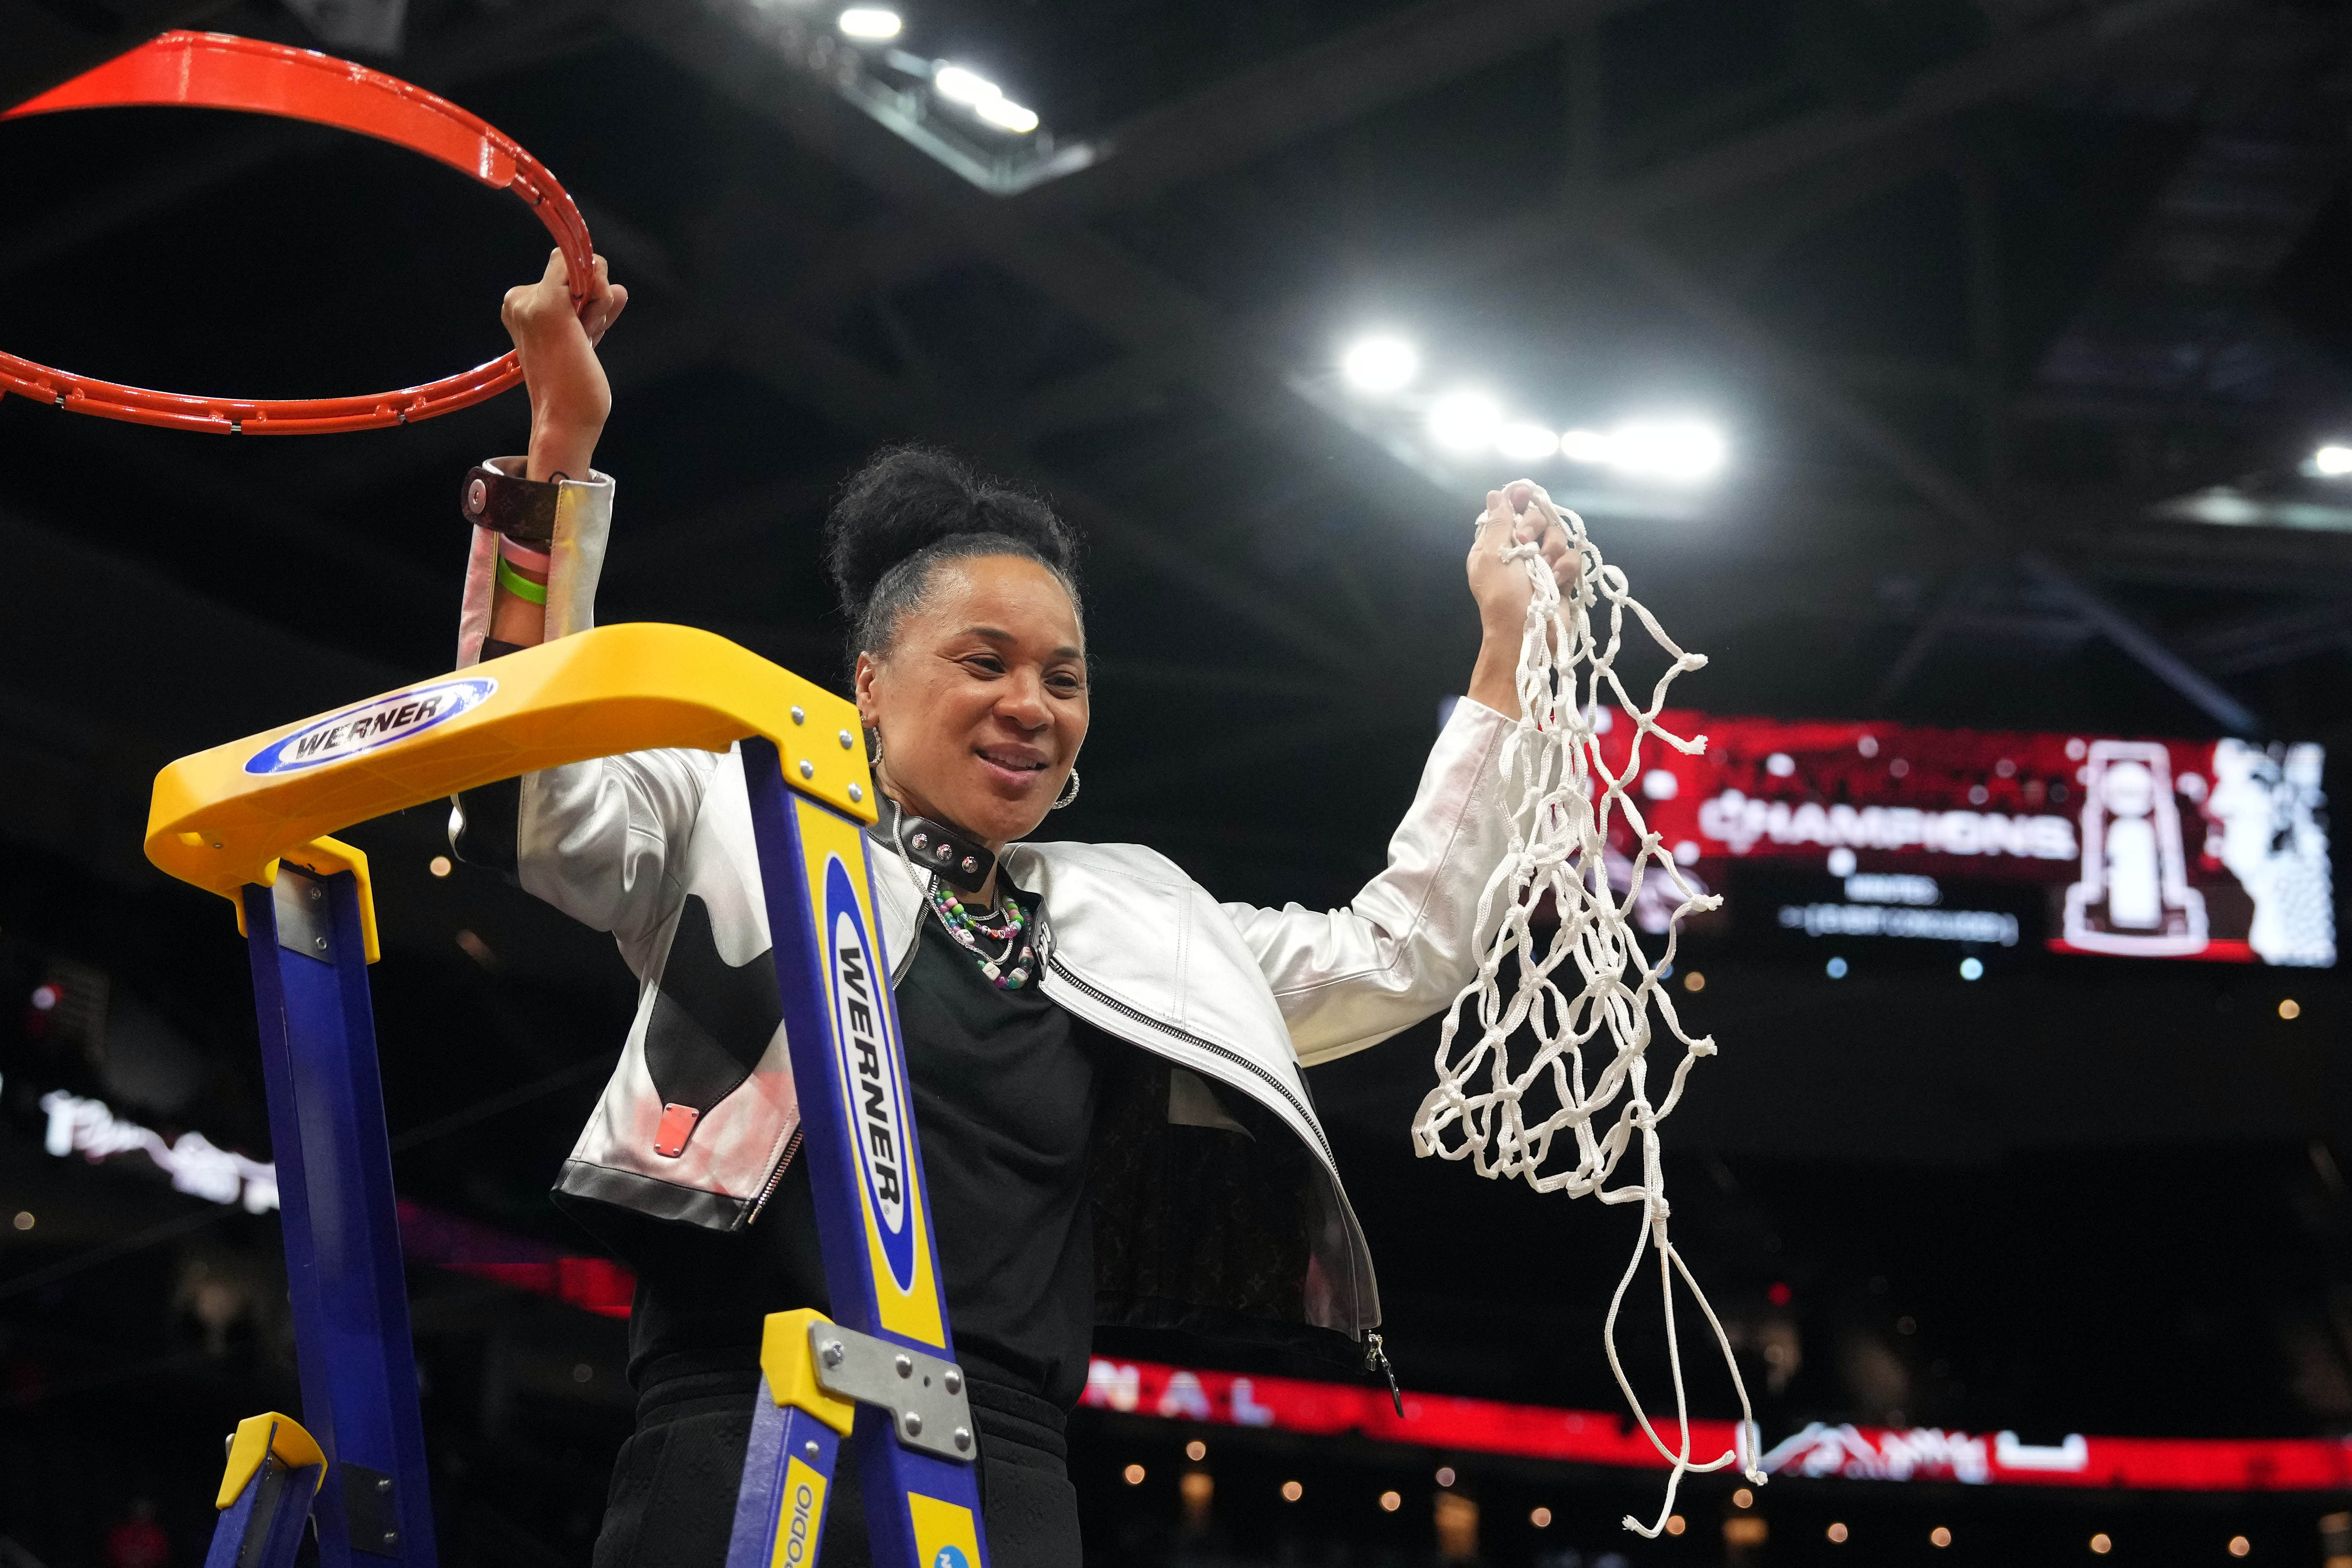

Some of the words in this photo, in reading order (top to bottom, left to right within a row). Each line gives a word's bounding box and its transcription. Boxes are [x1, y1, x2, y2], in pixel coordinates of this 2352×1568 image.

[296, 695, 442, 760] WERNER
[839, 947, 901, 1205] WERNER
[784, 1484, 812, 1568] ODIO
